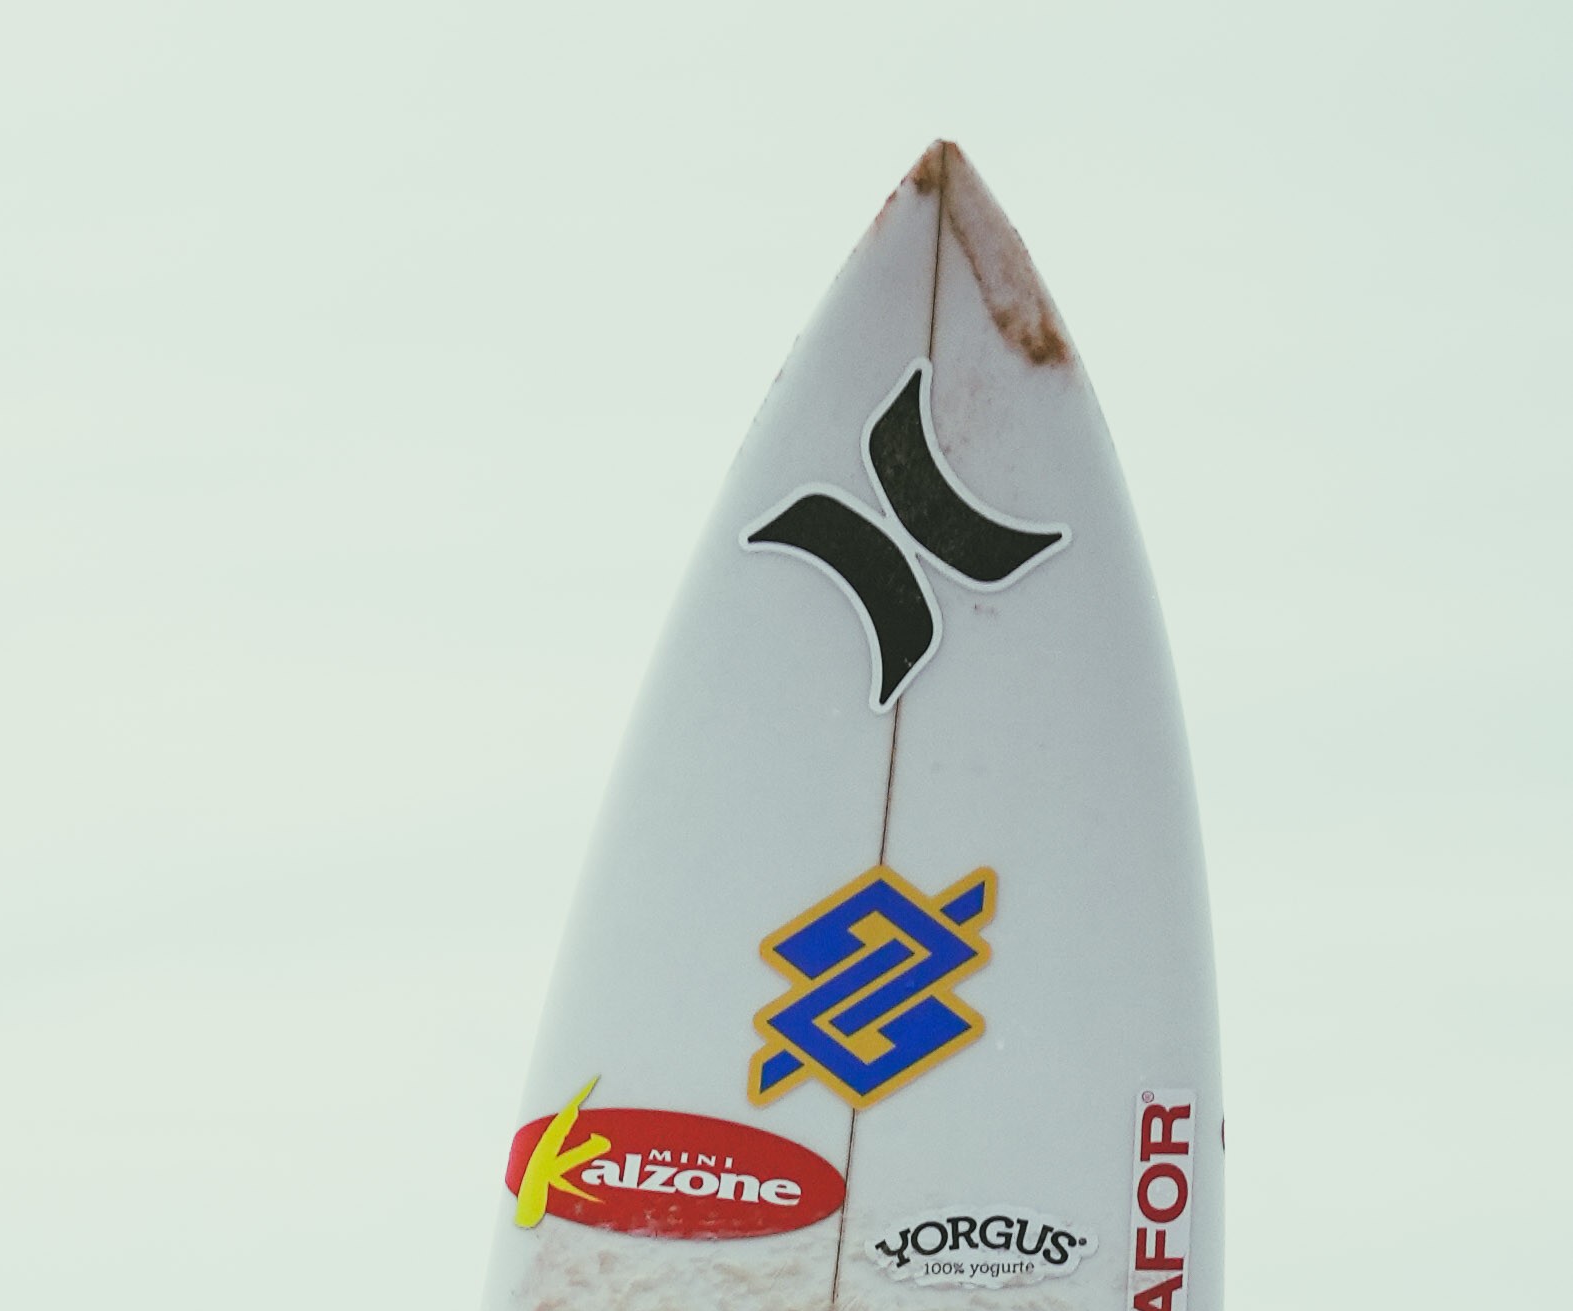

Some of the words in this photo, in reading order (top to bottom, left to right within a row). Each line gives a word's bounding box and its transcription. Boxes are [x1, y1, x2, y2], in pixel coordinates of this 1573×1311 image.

[514, 1074, 802, 1229] Kalzone
[648, 1149, 734, 1169] MINI
[874, 1214, 1078, 1268] YORGUS
[924, 1262, 965, 1275] 100%
[969, 1260, 1035, 1278] yogurte
